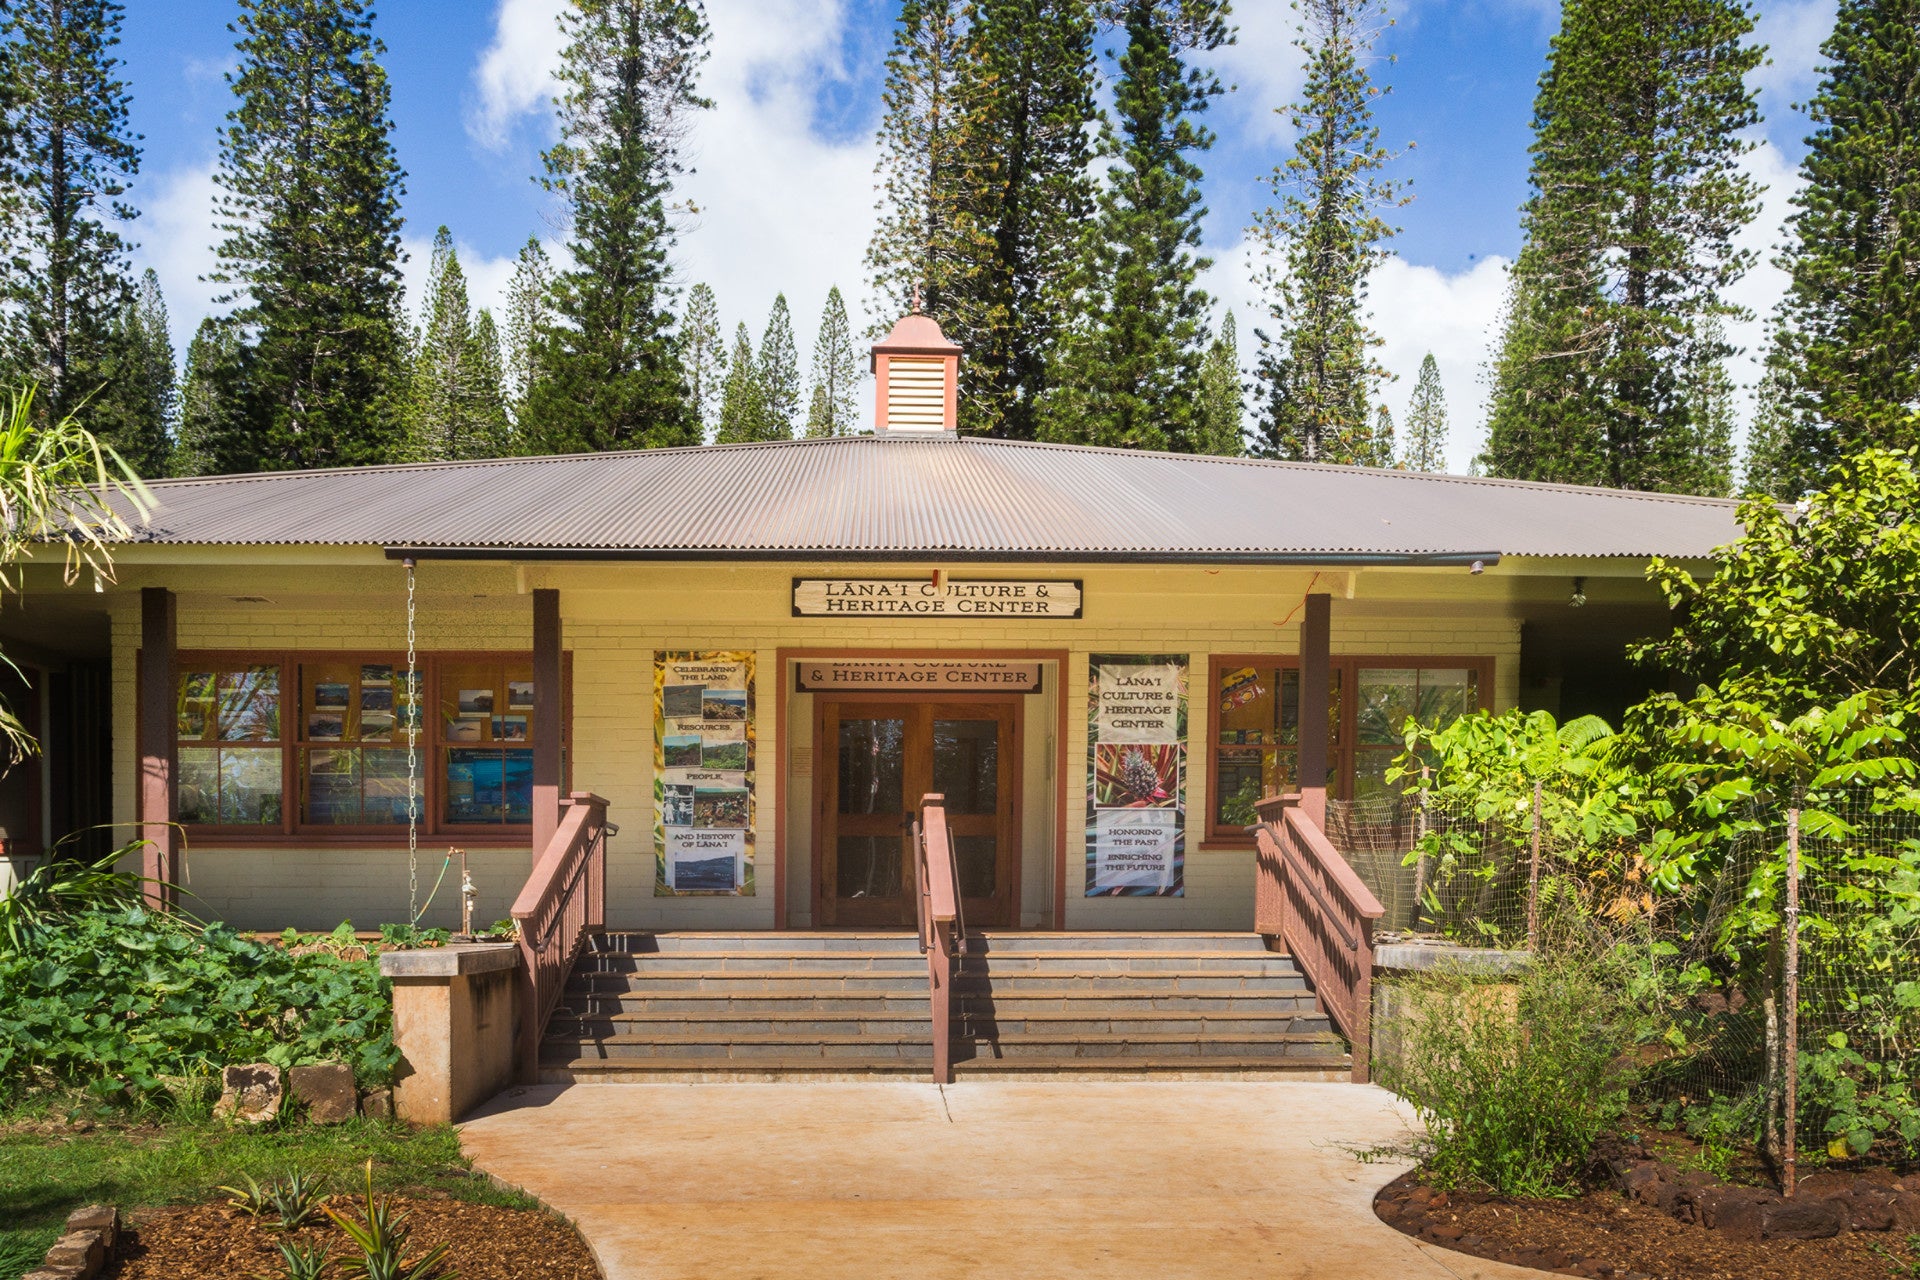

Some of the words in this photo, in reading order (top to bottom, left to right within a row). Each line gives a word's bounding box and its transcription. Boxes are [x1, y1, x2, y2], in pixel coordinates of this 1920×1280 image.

[1035, 584, 1050, 598] &
[826, 599, 945, 612] HERITAGE
[958, 600, 1050, 613] CENTER
[811, 670, 824, 682] &
[832, 670, 938, 682] HERITAGE
[946, 670, 1028, 683] CENTER
[1102, 692, 1163, 700] CULTURE
[1166, 692, 1174, 700] &
[1104, 706, 1172, 714] HERITAGE
[1112, 720, 1164, 728] CENTER
